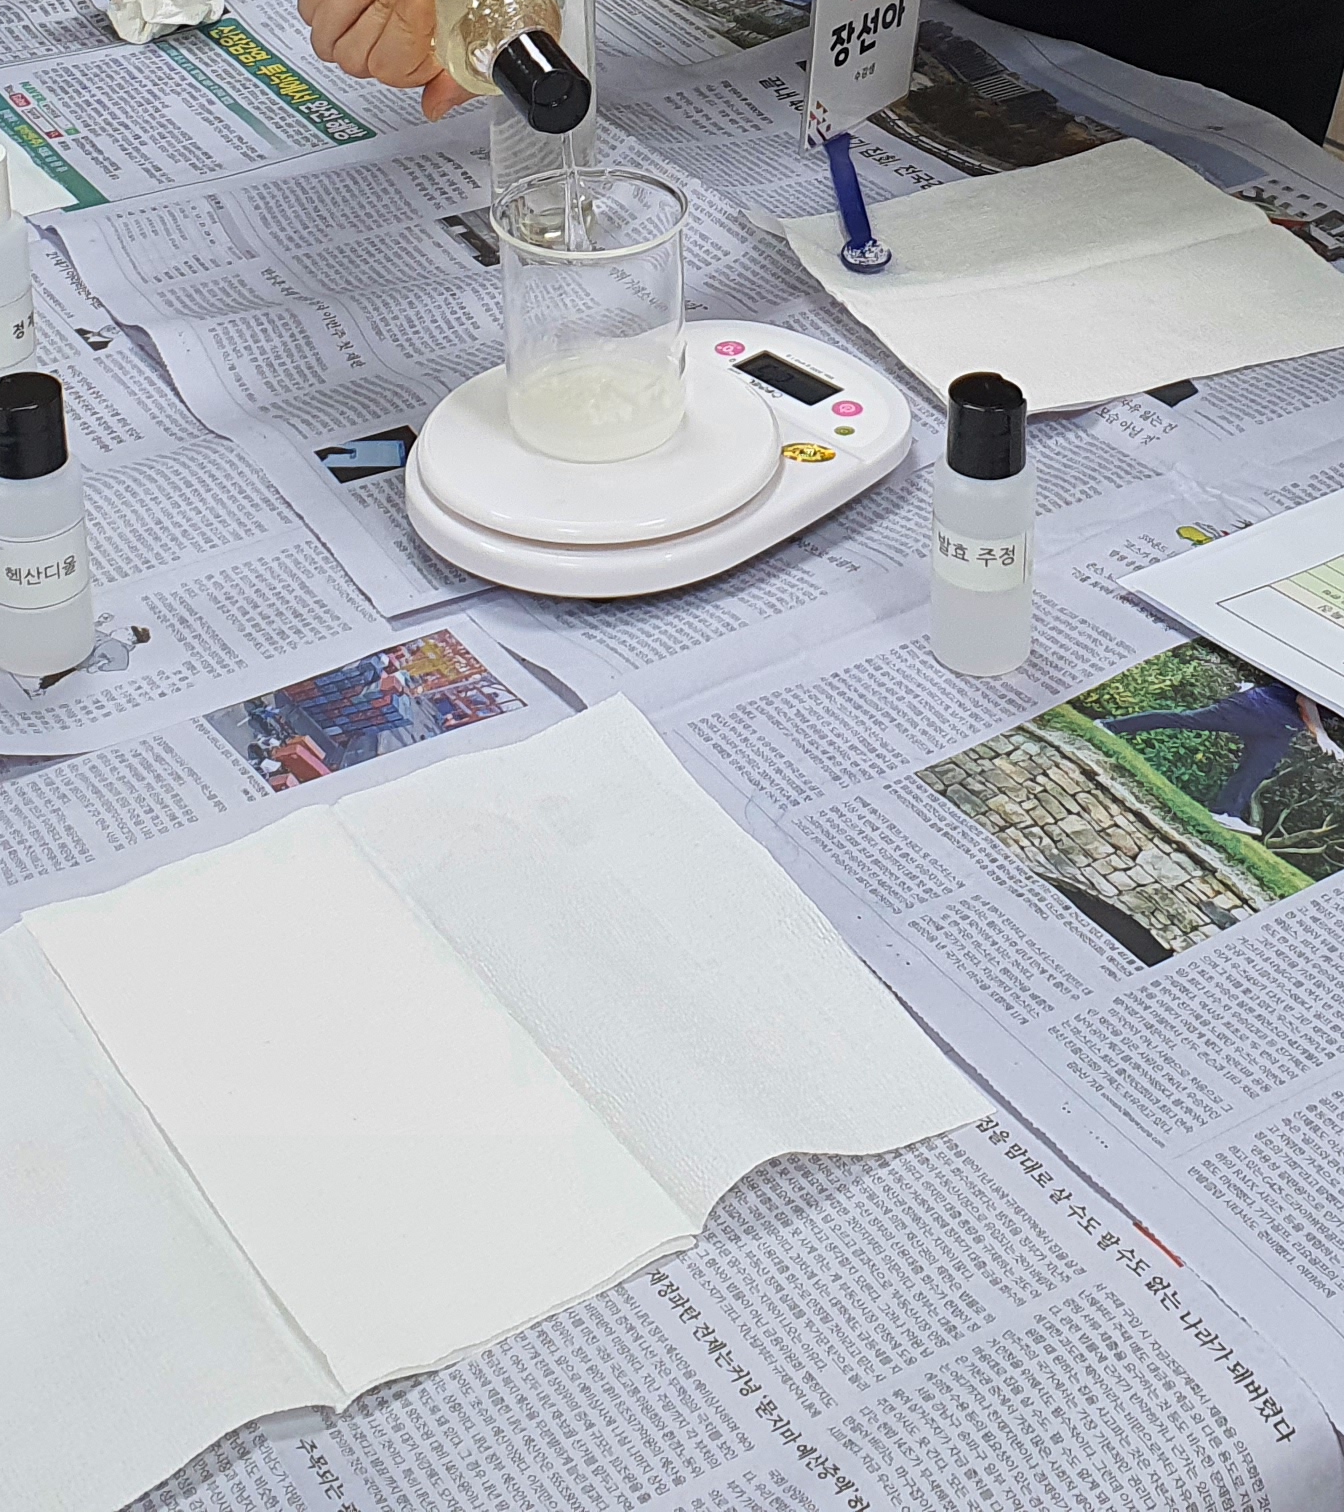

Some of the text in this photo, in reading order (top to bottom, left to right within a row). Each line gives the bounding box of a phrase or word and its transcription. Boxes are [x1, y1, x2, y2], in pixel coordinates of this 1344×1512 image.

[855, 62, 875, 80] 수강생
[937, 534, 1016, 567] 발효 주정
[975, 1115, 1296, 1443] 집을 맘대로 살 수도 팔 수도 없는 나라가 돼버렸다
[644, 1267, 702, 1325] 재정파탄
[692, 1321, 763, 1397] 견제는커녕
[295, 1438, 345, 1500] 주목되는
